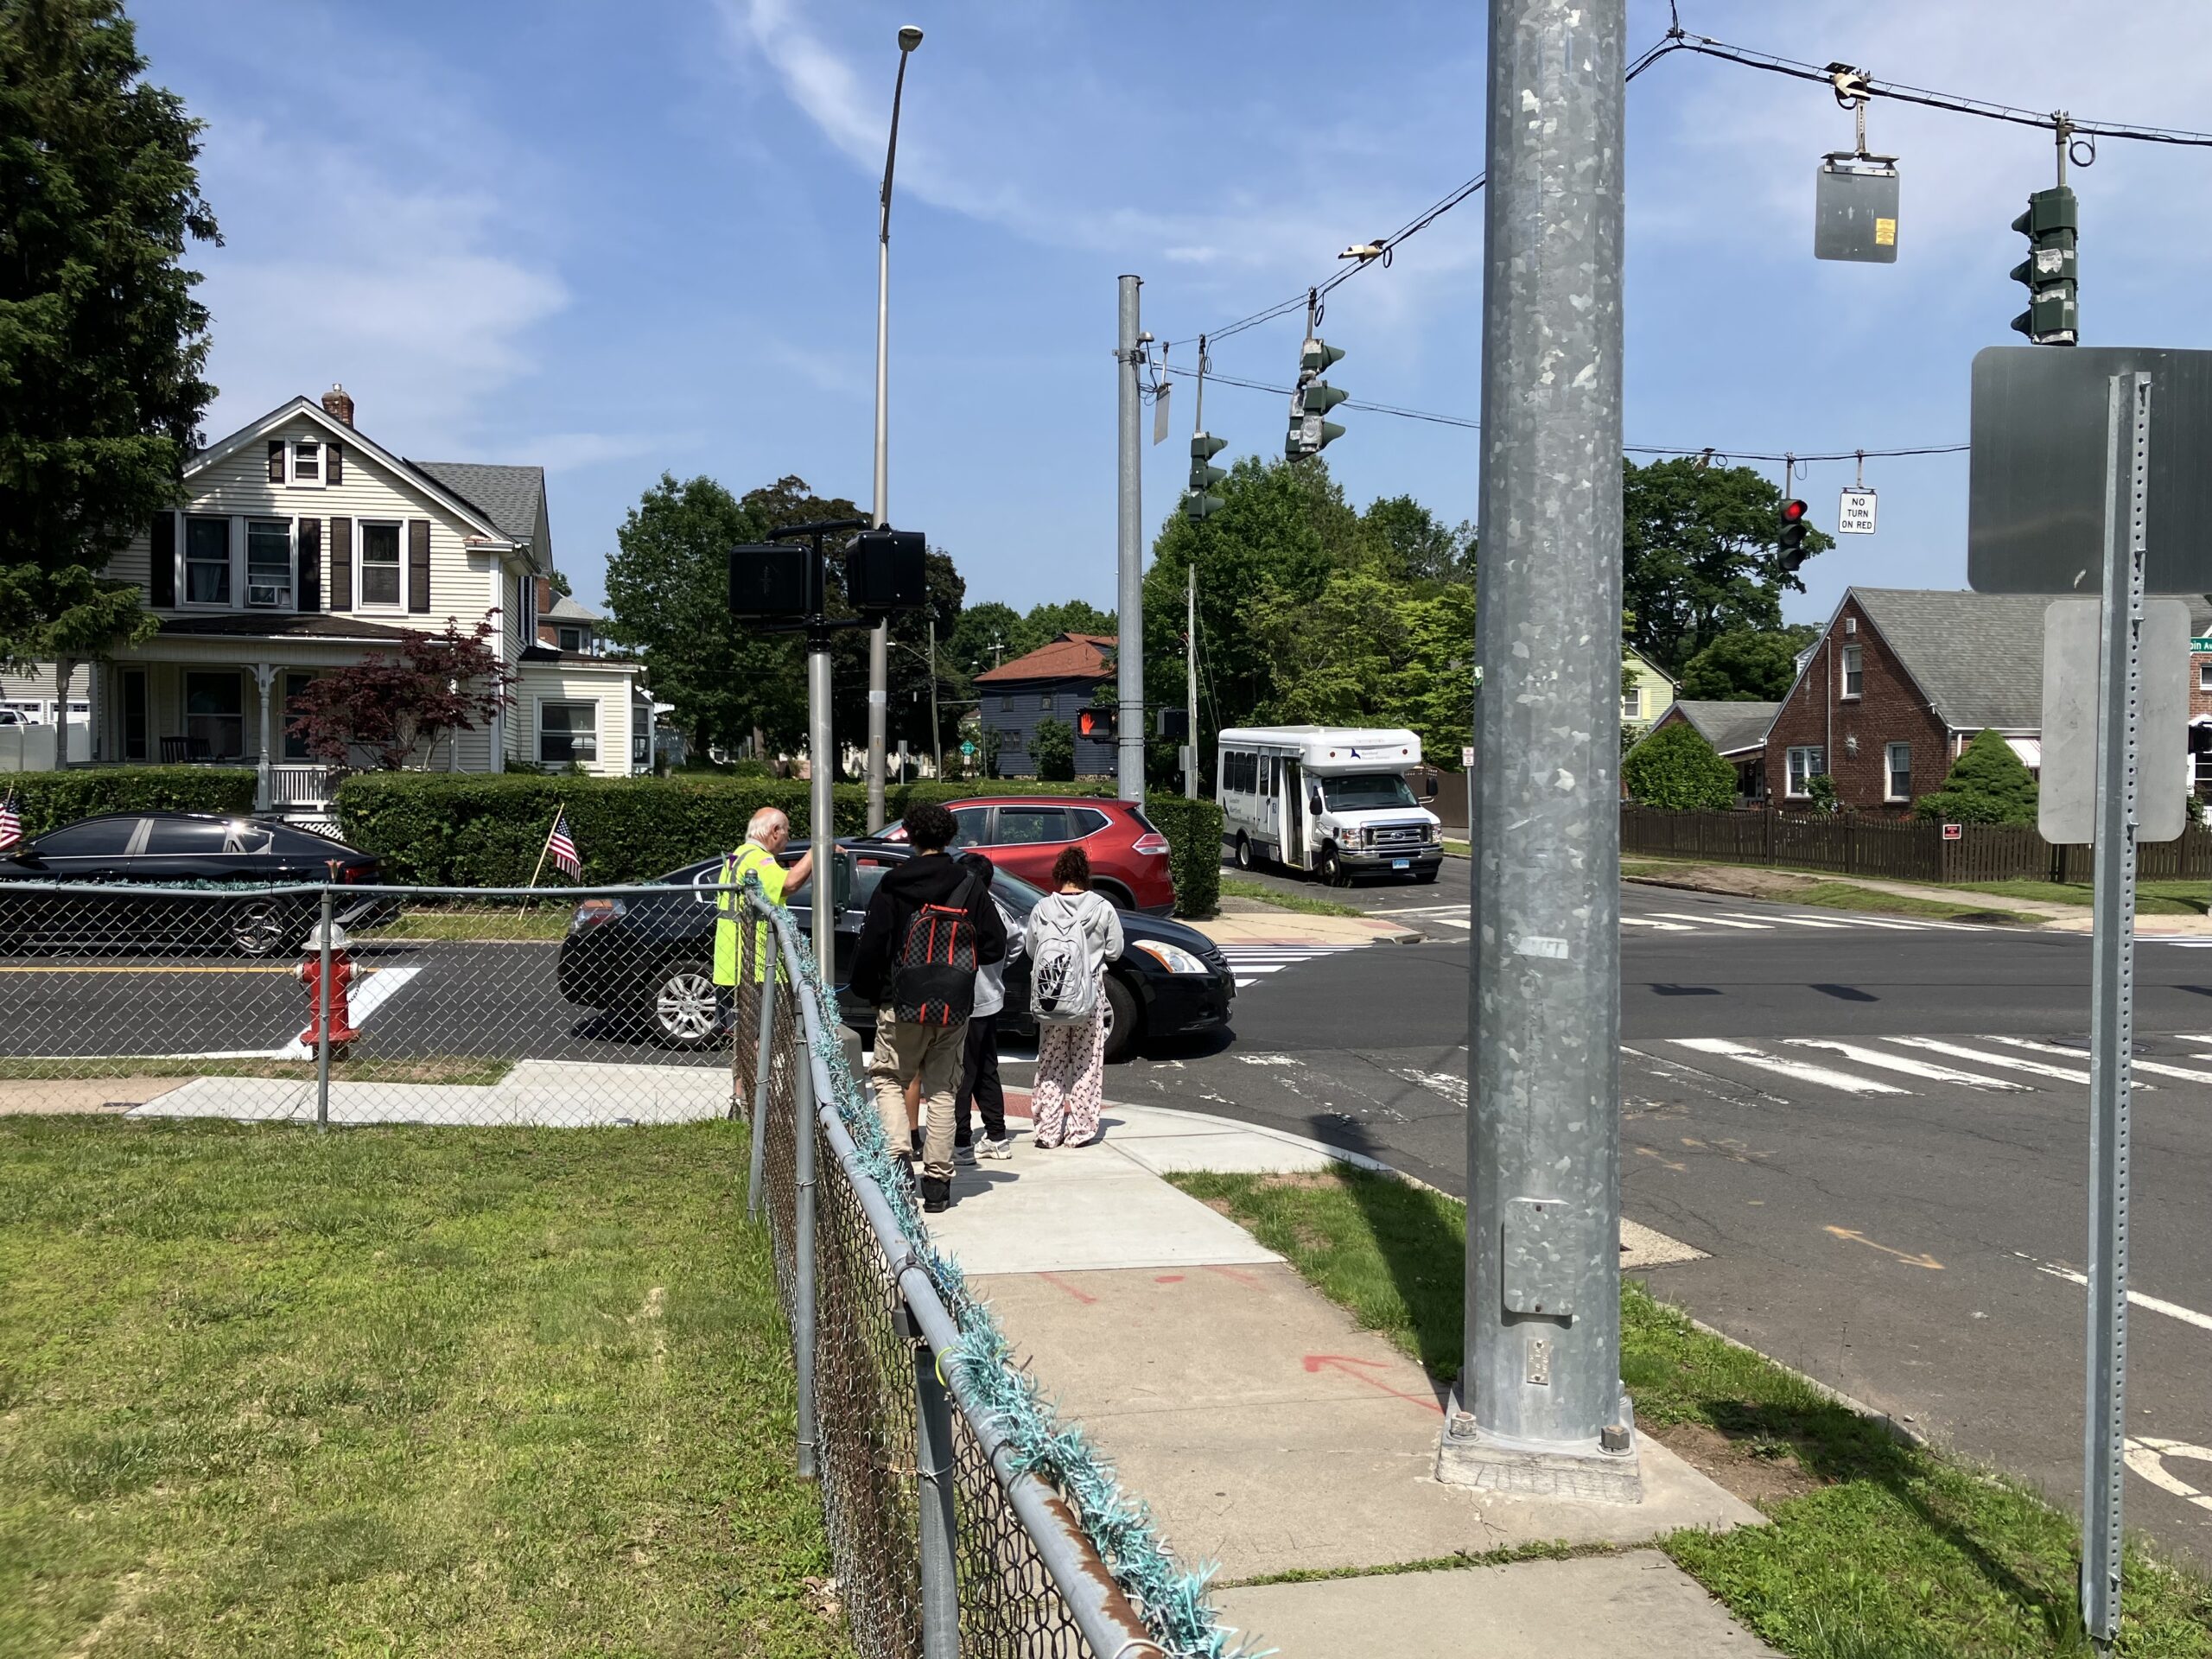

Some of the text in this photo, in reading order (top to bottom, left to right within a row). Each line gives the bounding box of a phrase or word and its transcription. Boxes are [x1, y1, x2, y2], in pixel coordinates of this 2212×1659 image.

[1852, 498, 1866, 506] NO
[1847, 509, 1869, 518] TURN
[1856, 521, 1872, 530] RED
